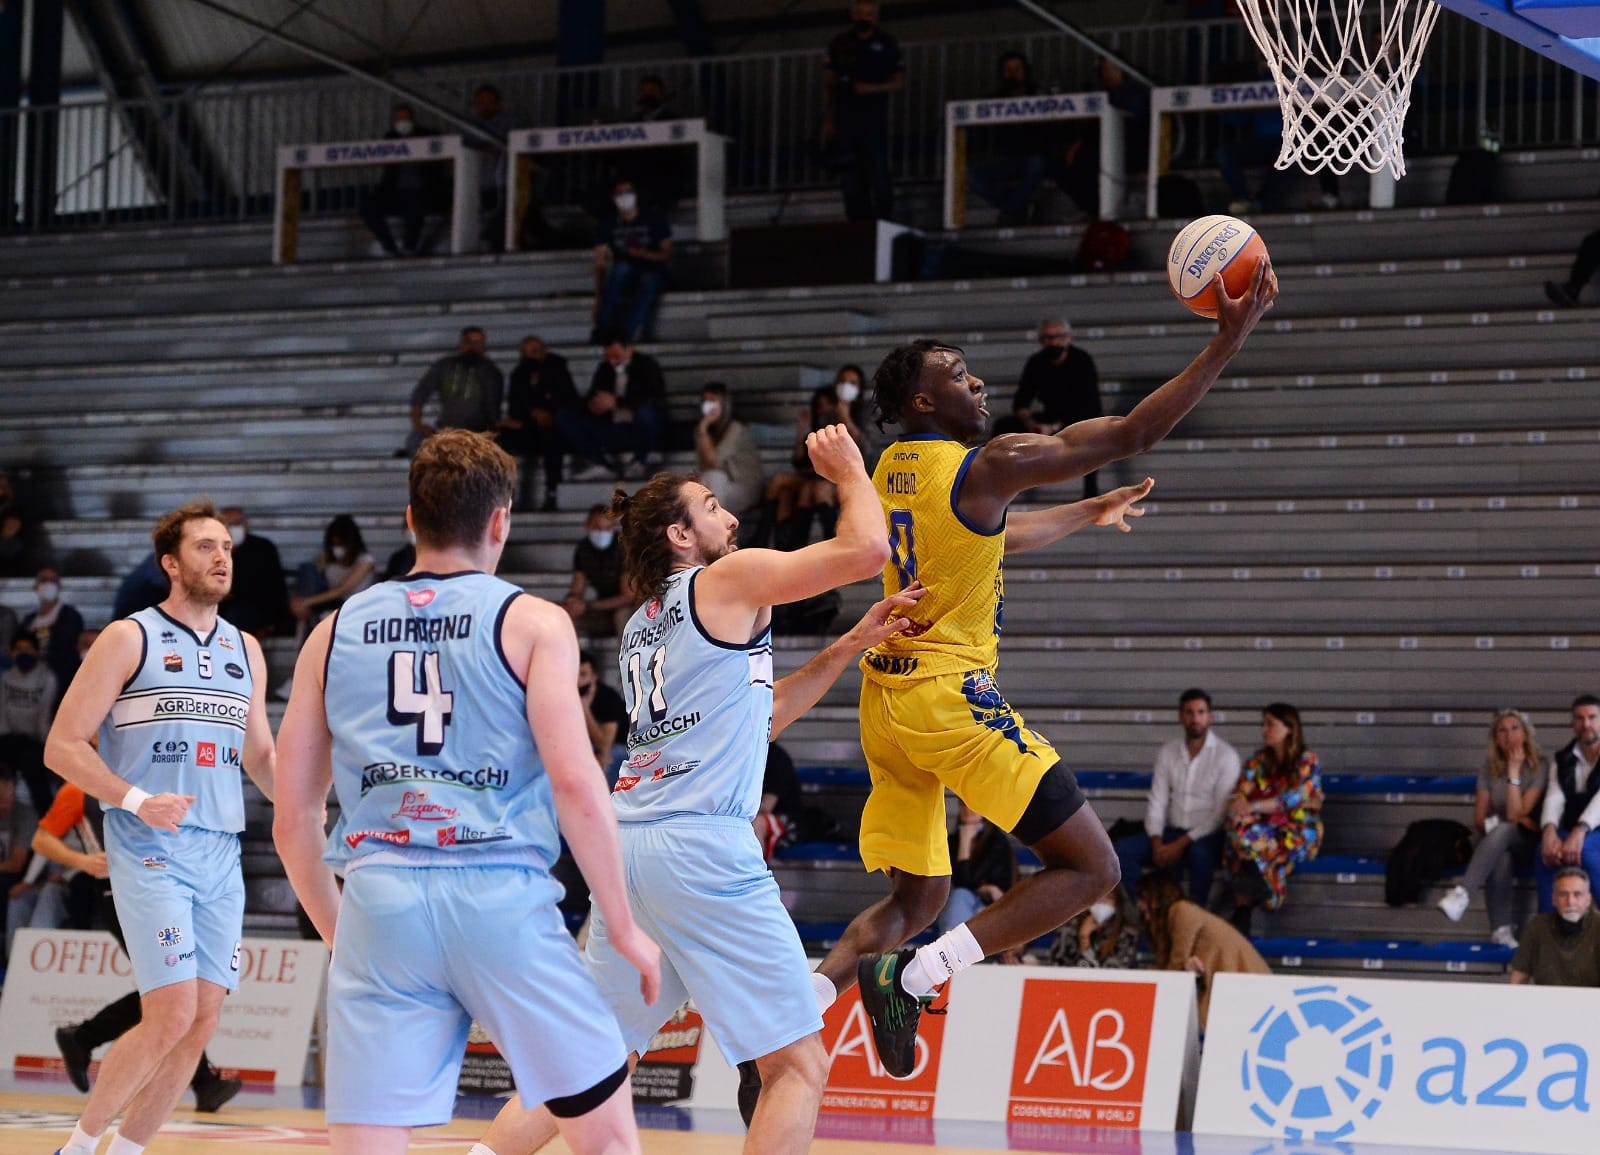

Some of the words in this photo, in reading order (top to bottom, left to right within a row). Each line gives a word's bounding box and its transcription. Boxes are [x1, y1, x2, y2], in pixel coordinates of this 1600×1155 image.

[977, 99, 1076, 119] STAMPA
[557, 126, 647, 146] STAMPA
[325, 142, 411, 161] STAMPA
[1187, 223, 1240, 279] SPALDING
[363, 614, 472, 644] GIORDANO
[197, 649, 213, 679] 5
[628, 643, 668, 735] 11
[386, 651, 454, 757] 4
[151, 754, 188, 764] BORGOVET
[461, 826, 487, 840] Iter
[1024, 1008, 1135, 1091] AB
[1415, 1036, 1591, 1113] a2a
[892, 1097, 929, 1112] WORLD
[1012, 1103, 1092, 1120] COGENERATION
[1096, 1108, 1135, 1122] WORLD
